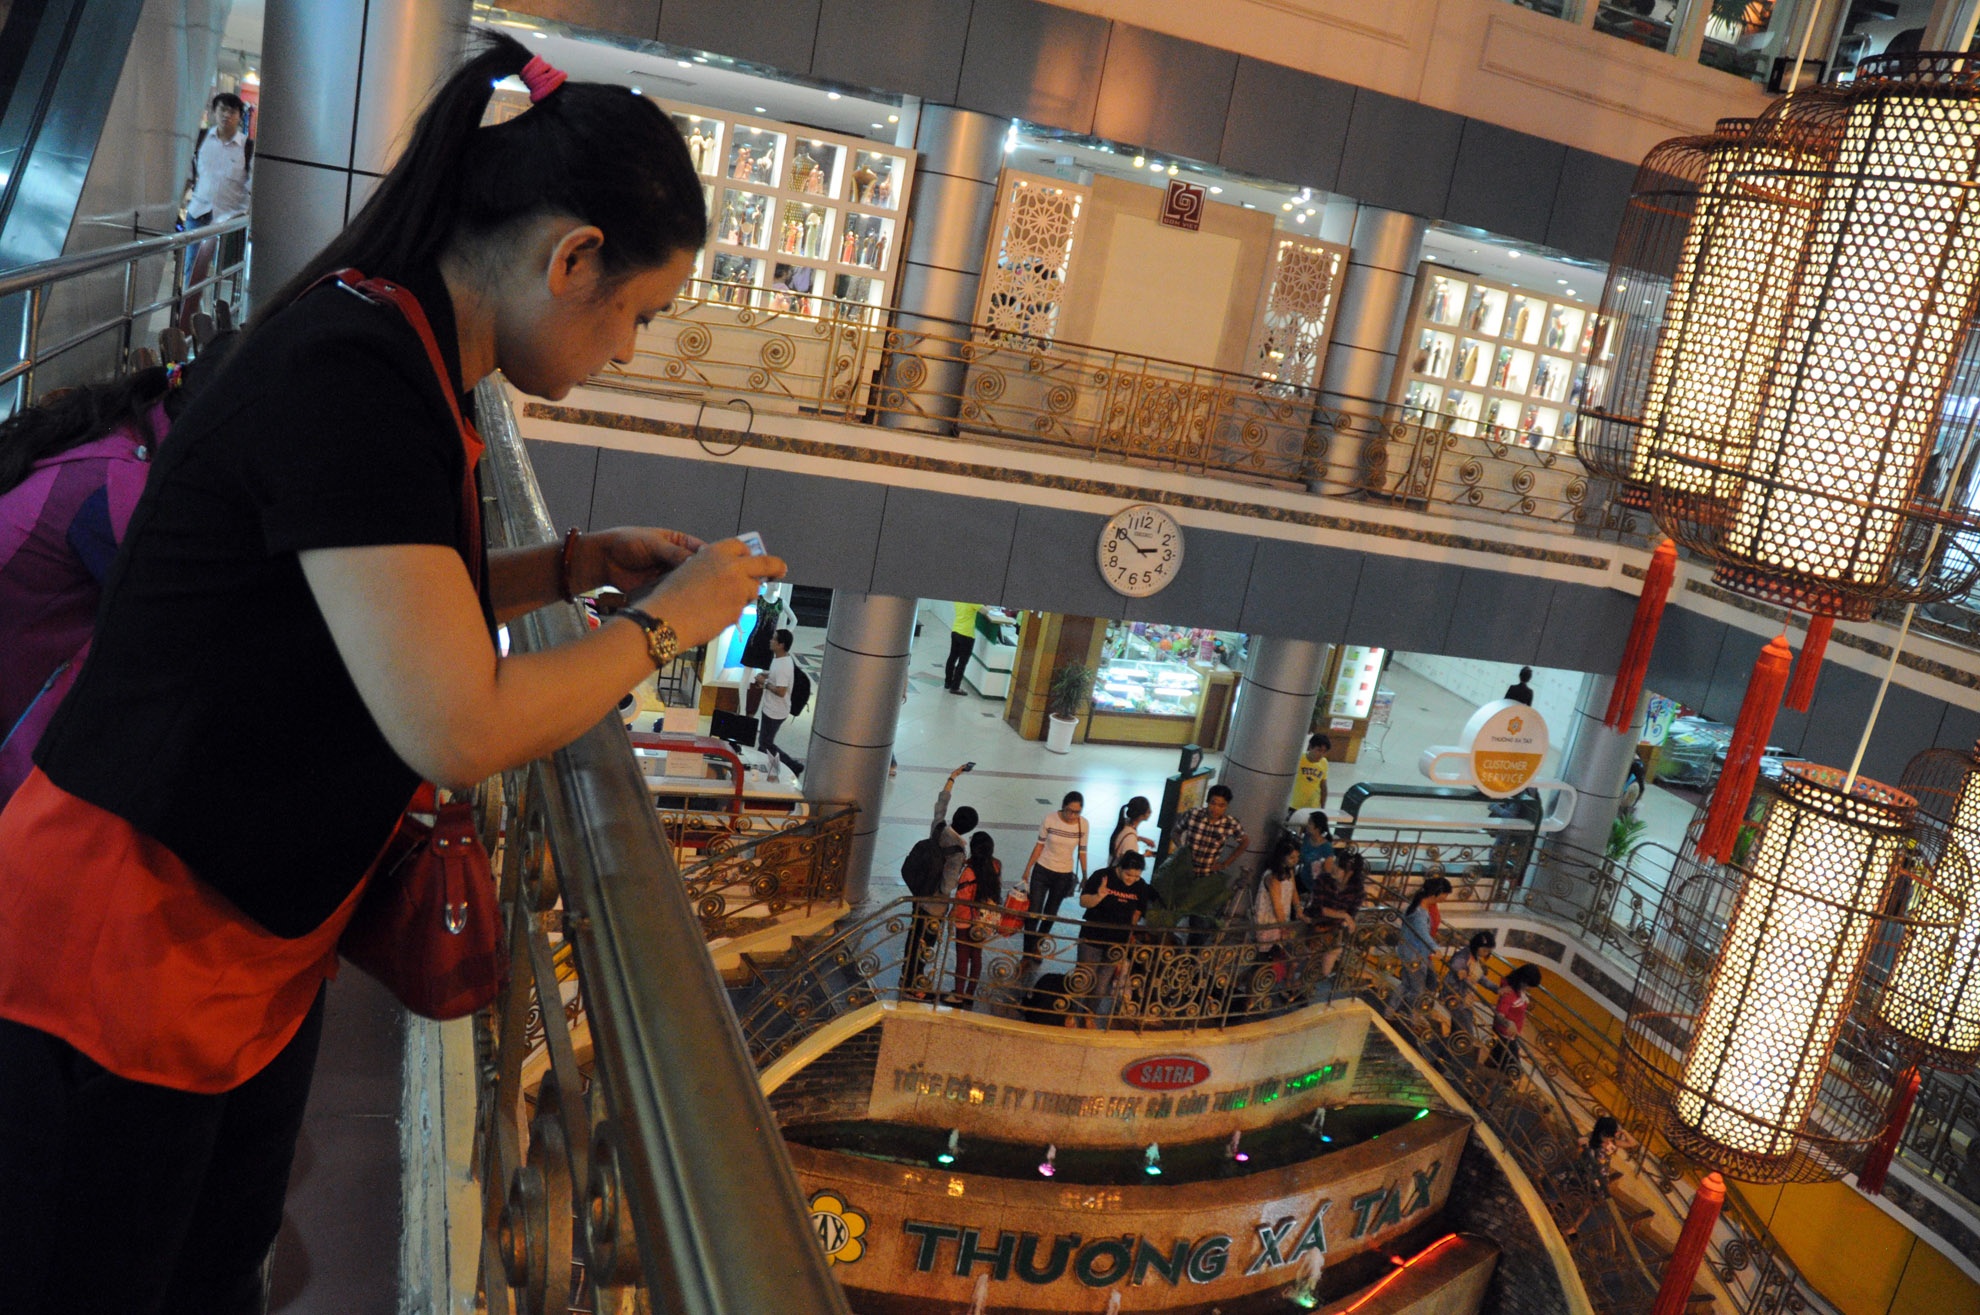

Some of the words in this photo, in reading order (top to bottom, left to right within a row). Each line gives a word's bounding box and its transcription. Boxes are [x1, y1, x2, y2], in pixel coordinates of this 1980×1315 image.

[1128, 517, 1139, 530] 11
[1140, 516, 1154, 529] 12
[1108, 540, 1117, 553] 9
[1162, 534, 1171, 546] 2
[1109, 555, 1118, 568] 8
[1162, 549, 1172, 561] 3
[1118, 567, 1127, 580] 7
[1154, 563, 1163, 574] 4
[1128, 573, 1138, 585] 6
[1142, 571, 1152, 583] 5
[1482, 759, 1529, 771] CUSTOMER
[1481, 772, 1525, 784] SERVICE
[1140, 1065, 1195, 1083] SATRA
[904, 1218, 1233, 1288] THƯƠNG
[1351, 1160, 1441, 1239] TAX
[813, 1213, 845, 1251] AX
